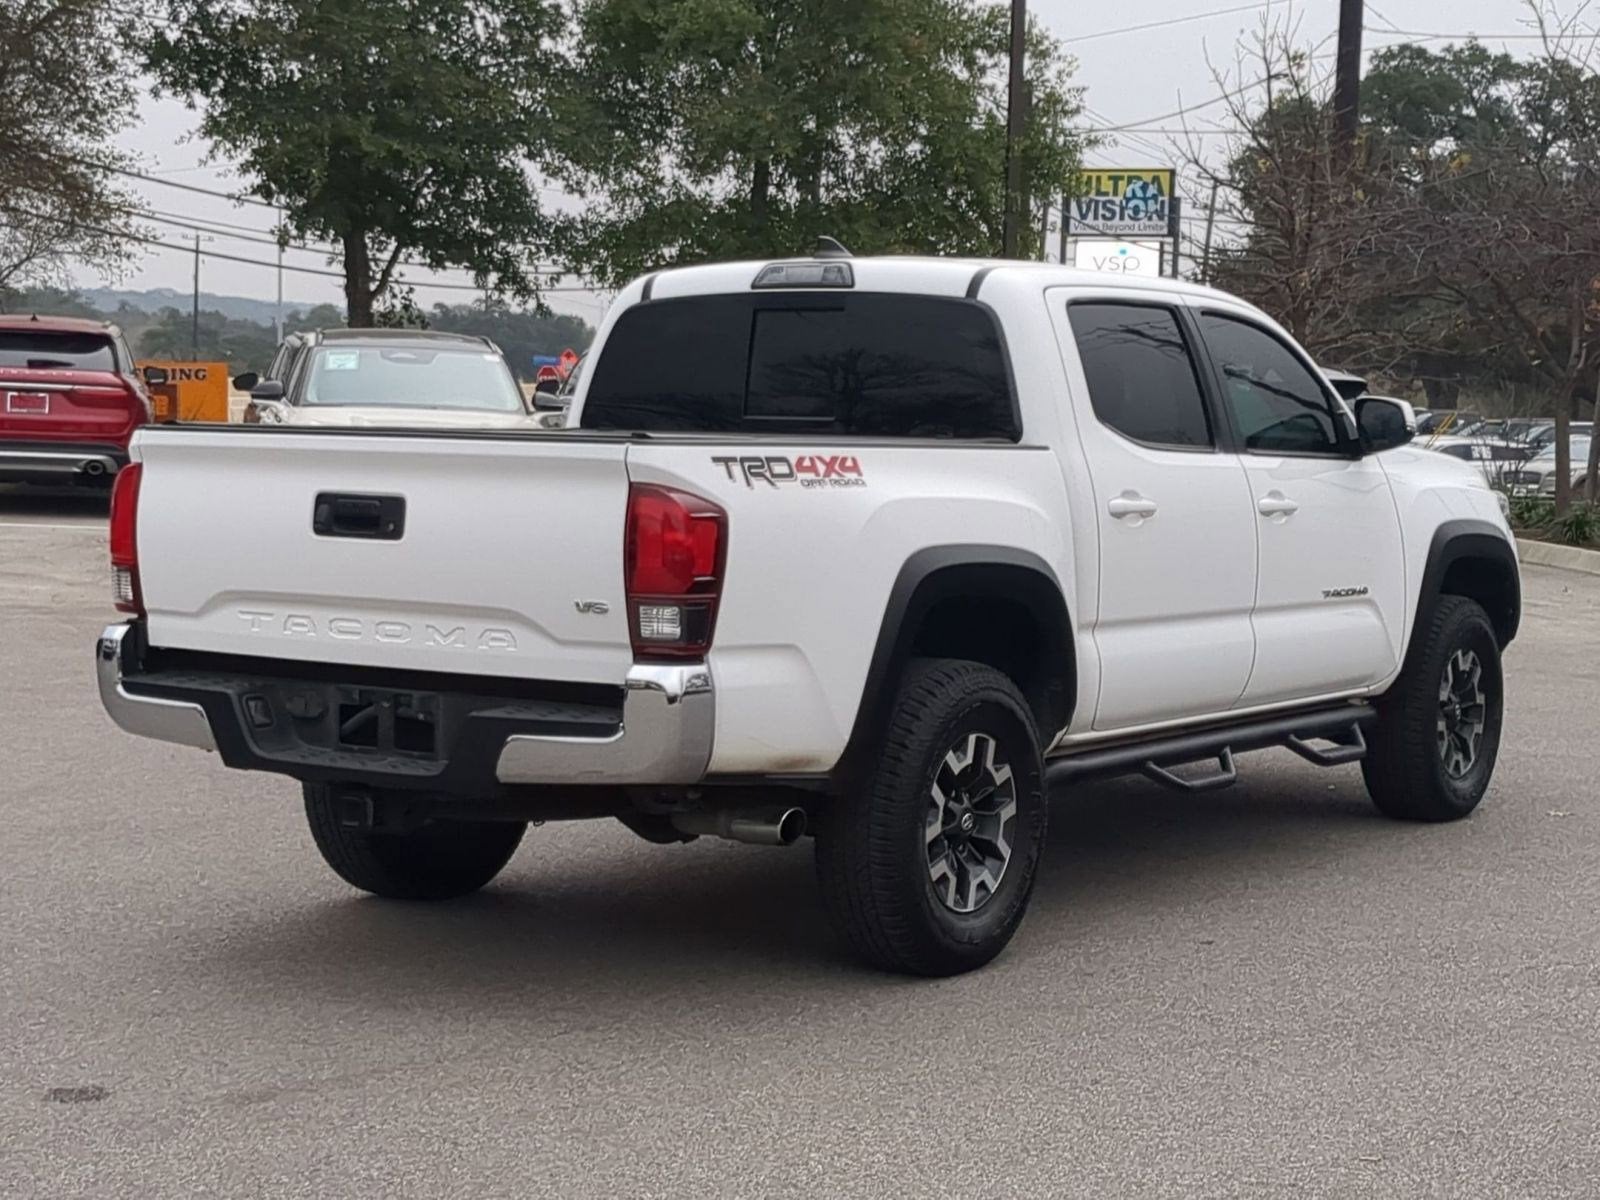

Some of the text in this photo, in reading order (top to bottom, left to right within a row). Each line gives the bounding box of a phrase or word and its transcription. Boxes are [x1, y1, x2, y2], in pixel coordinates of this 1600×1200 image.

[1076, 198, 1166, 222] VISION
[1092, 255, 1141, 274] vsp
[711, 456, 797, 490] TRD
[828, 478, 868, 488] ROAD
[1321, 586, 1369, 599] TACOMA
[574, 601, 609, 614] V6
[238, 610, 519, 651] TACOMA
